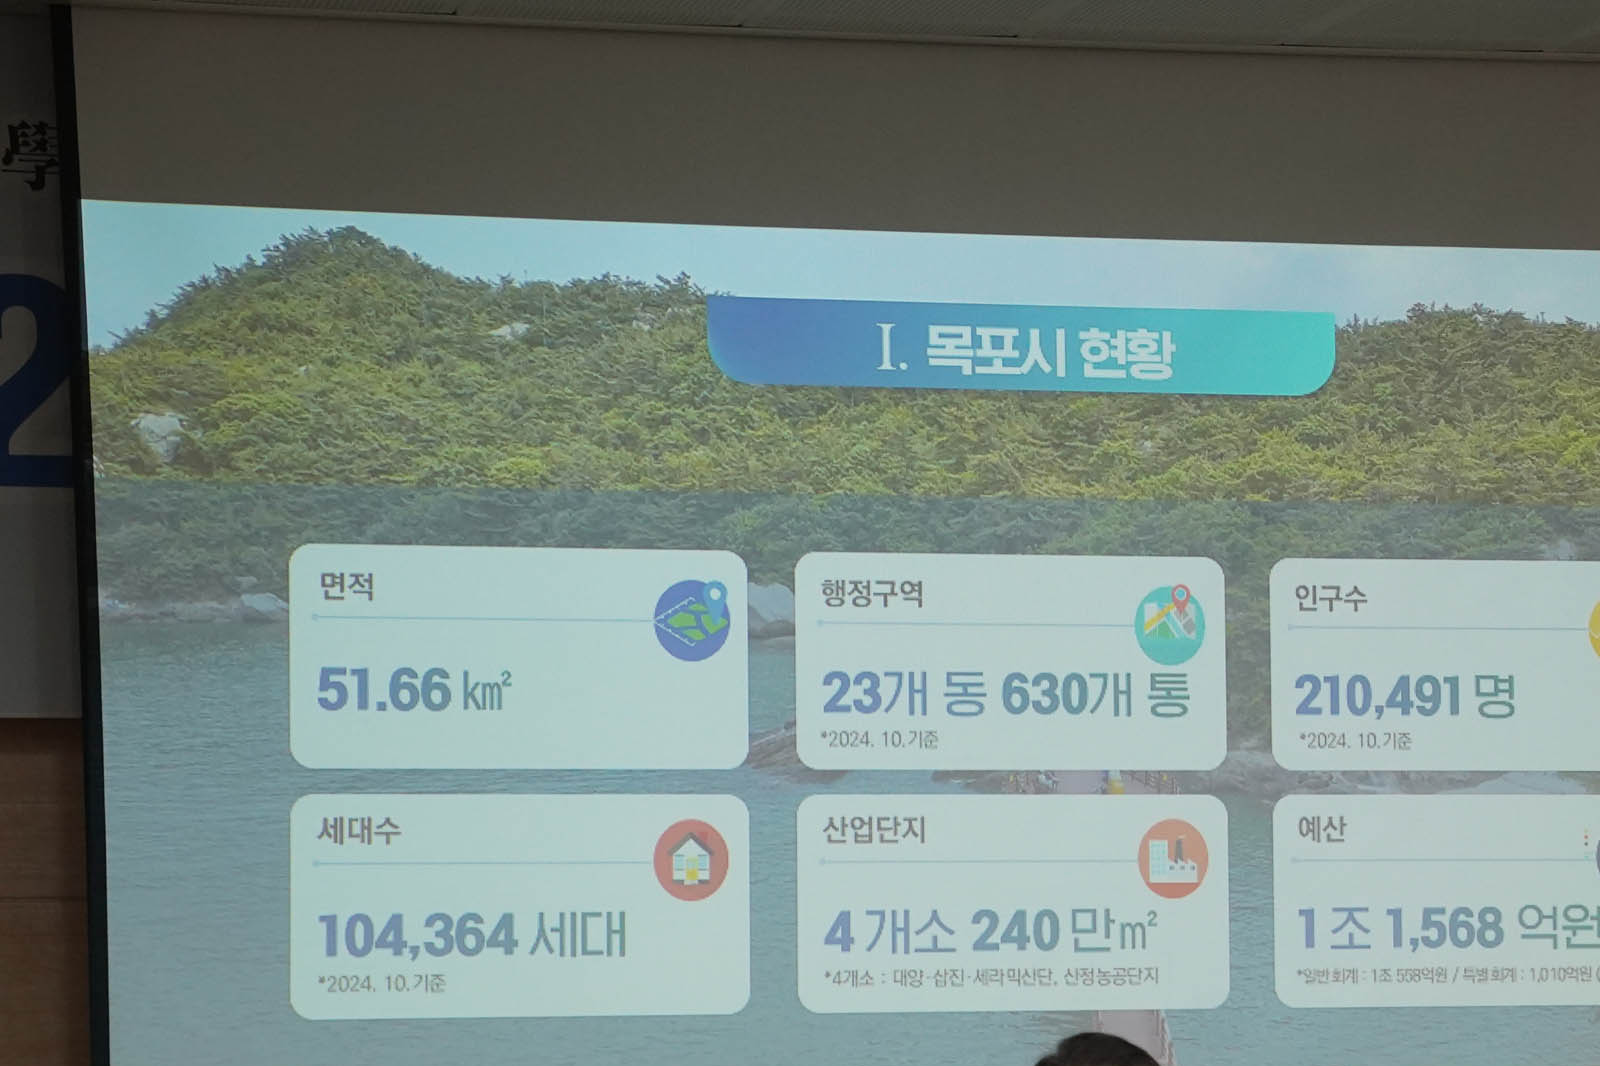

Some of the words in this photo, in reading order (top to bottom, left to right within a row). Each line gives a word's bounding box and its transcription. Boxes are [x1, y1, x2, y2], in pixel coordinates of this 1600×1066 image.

[926, 324, 1066, 378] 목포시
[1078, 327, 1176, 381] 현황
[320, 571, 374, 601] 면적
[821, 580, 924, 608] 행정구역
[1295, 585, 1368, 612] 인구수
[317, 667, 452, 712] 51.66
[822, 670, 928, 716] 23개
[943, 671, 988, 717] 동
[1001, 671, 1132, 717] 630개
[1147, 672, 1191, 718] 통
[1294, 673, 1460, 720] 210,491
[1474, 674, 1516, 719] 명
[317, 816, 402, 846] 세대수
[823, 815, 926, 844] 산업단지
[1299, 815, 1347, 843] 예산
[318, 912, 518, 961] 104,364
[529, 910, 626, 957] 세대
[970, 908, 1060, 952] 240
[1385, 906, 1505, 953] 1,568
